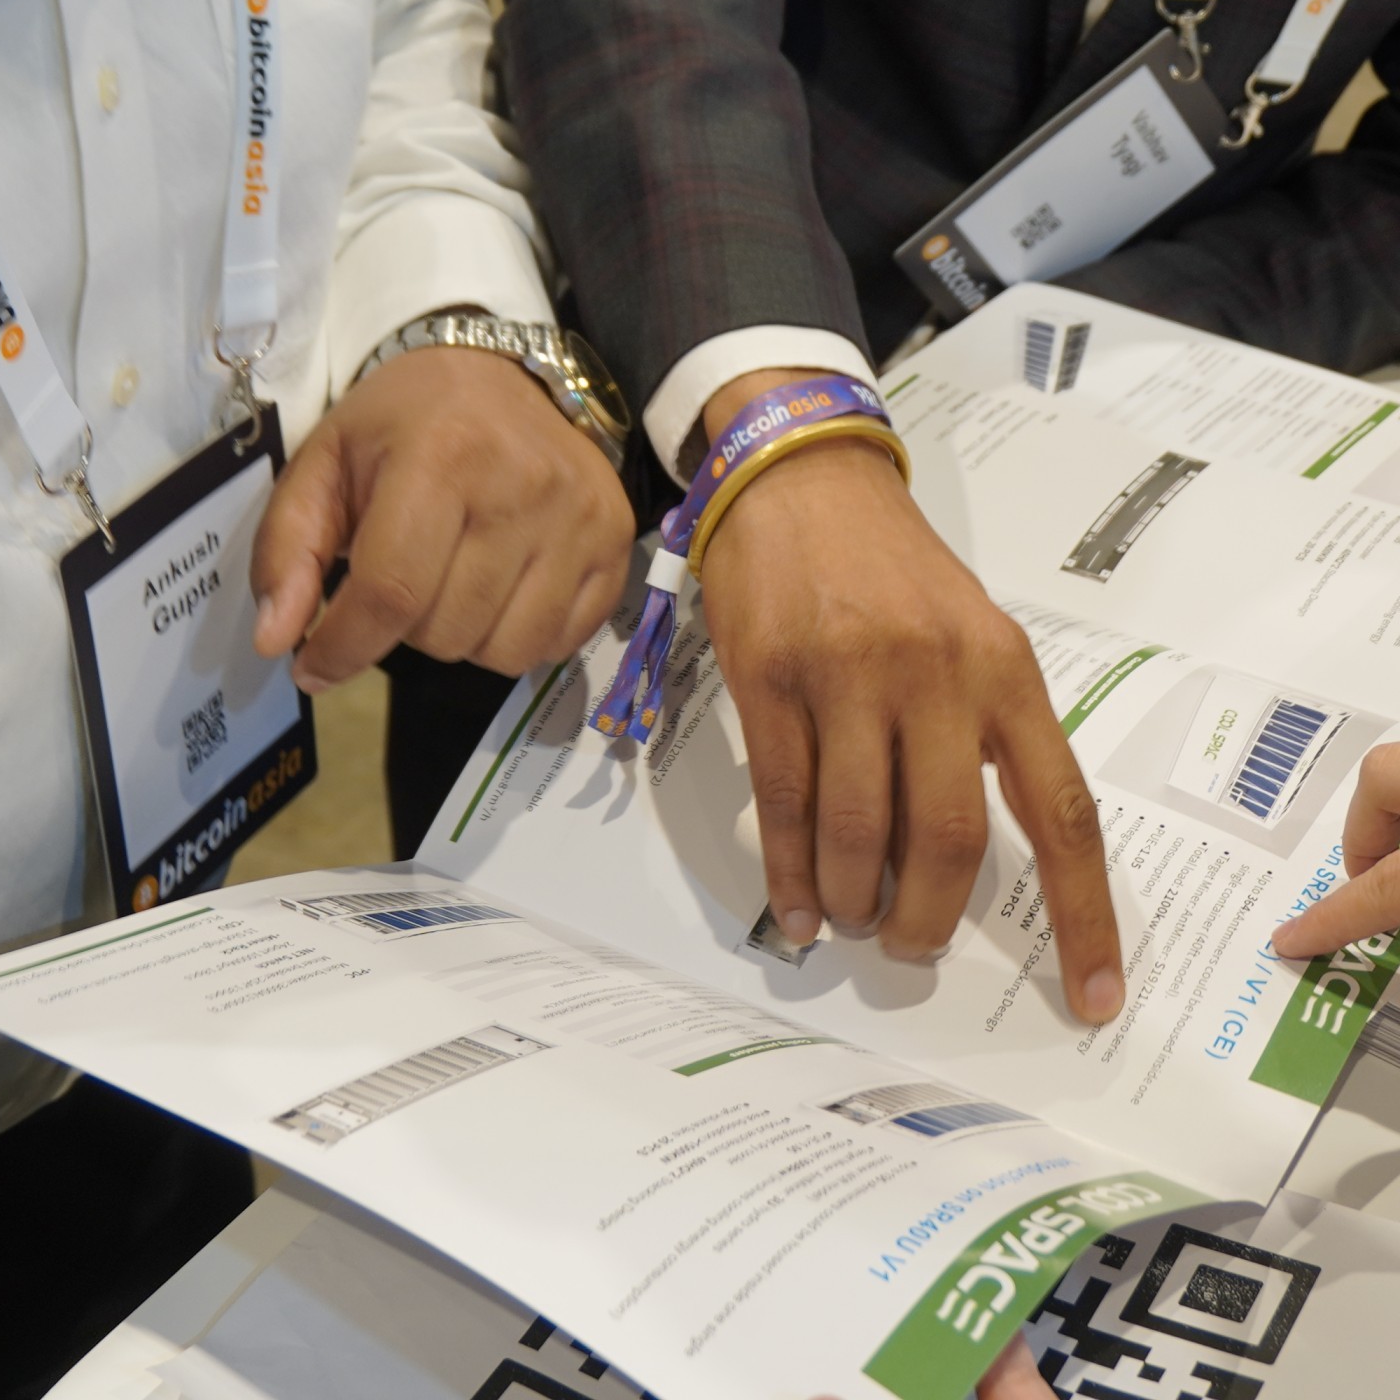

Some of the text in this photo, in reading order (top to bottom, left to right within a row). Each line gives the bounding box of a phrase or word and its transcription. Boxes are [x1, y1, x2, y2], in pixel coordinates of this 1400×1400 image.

[241, 17, 269, 216] bitcoinasia
[1111, 138, 1150, 180] Tyagi
[929, 243, 986, 312] bitcoin
[722, 392, 832, 464] bitcoinasia
[142, 531, 220, 607] Ankush
[1295, 548, 1311, 561] PCS
[1311, 568, 1336, 594] Stacking
[152, 570, 221, 635] Gupta
[1298, 593, 1319, 617] Design
[670, 632, 696, 661] 24port
[1370, 619, 1390, 644] energy
[577, 655, 591, 667] All
[672, 638, 711, 686] NET Switch
[556, 677, 575, 696] One
[539, 698, 560, 725] water
[1216, 709, 1238, 731] COOL
[524, 726, 542, 747] tank
[543, 746, 573, 782] built-in
[526, 784, 546, 812] cable
[157, 746, 303, 898] bitcoinasia
[1108, 818, 1143, 864] Integrated
[1131, 827, 1164, 869] PUE<1.05
[1186, 847, 1208, 866] Total
[1140, 837, 1184, 897] consumption)
[1174, 866, 1194, 888] load:
[1258, 874, 1272, 886] Up
[1302, 868, 1336, 900] SR2
[1013, 879, 1027, 894] 20
[1001, 895, 1019, 917] PCS
[1020, 892, 1043, 931] 000KW
[1149, 888, 1178, 930] 2100kw
[1165, 864, 1250, 998] single container (40ft model).
[1209, 894, 1258, 964] 364xAntminers
[1101, 856, 1230, 1063] Target Miner: AntMiner: S19/21 hydro series
[1124, 931, 1154, 978] (involves
[1004, 953, 1040, 998] Stacking
[1193, 966, 1213, 998] could
[1239, 980, 1267, 1004] V1
[1301, 926, 1388, 1036] PACE
[985, 998, 1013, 1032] Design
[1185, 998, 1200, 1012] be
[1162, 1013, 1192, 1054] housed
[1205, 1010, 1247, 1059] (CE)
[1143, 1053, 1167, 1084] inside
[1131, 1085, 1147, 1105] one
[675, 1225, 710, 1254] energy
[894, 1200, 966, 1255] SR40U
[867, 1251, 907, 1283] V1
[936, 1205, 1087, 1343] SPACE
